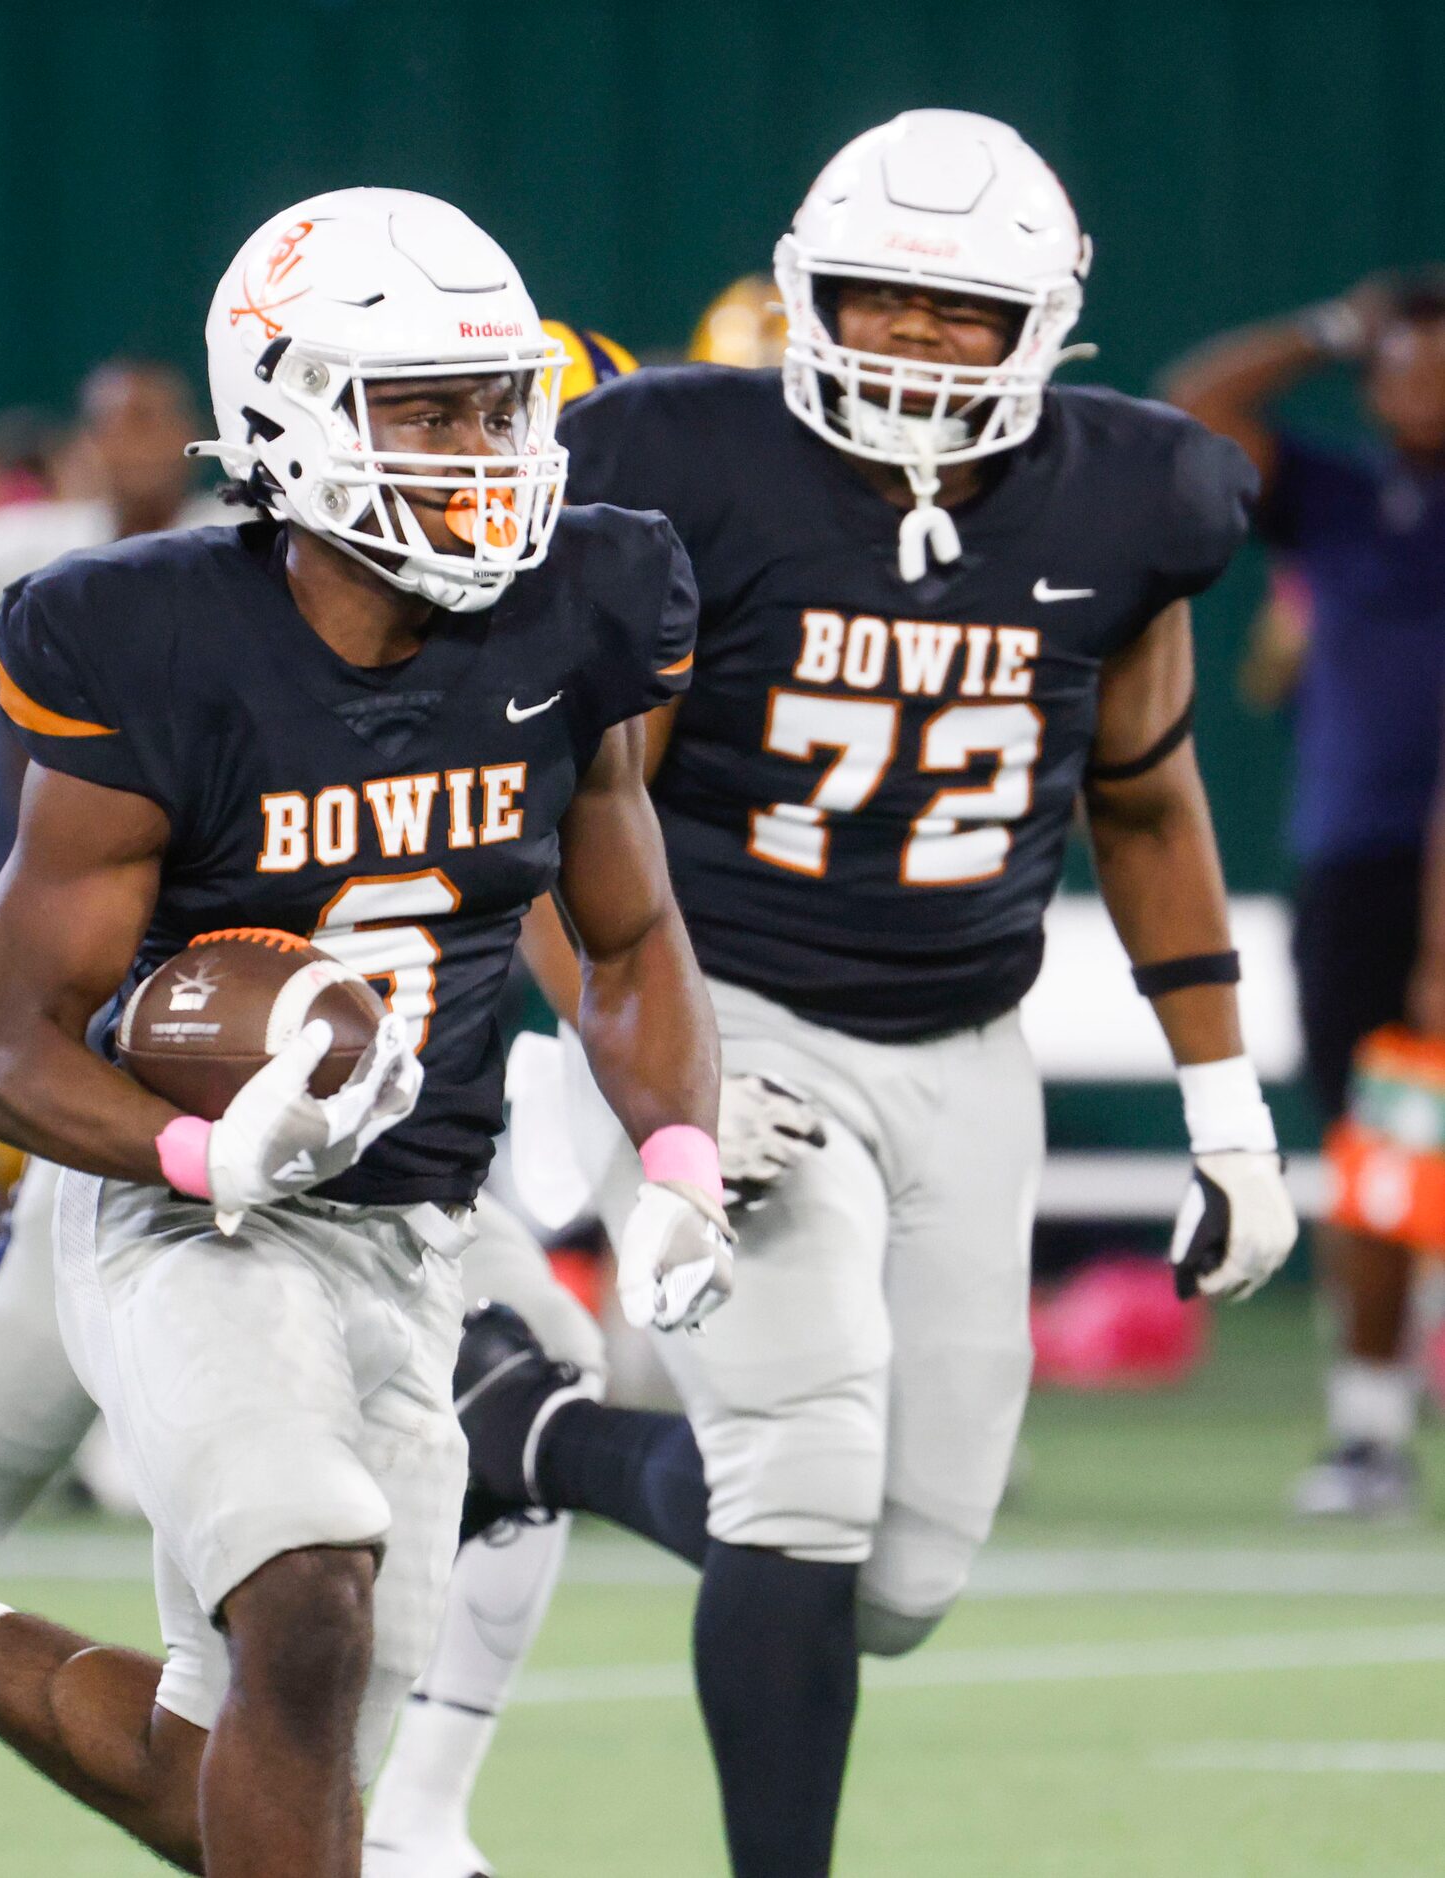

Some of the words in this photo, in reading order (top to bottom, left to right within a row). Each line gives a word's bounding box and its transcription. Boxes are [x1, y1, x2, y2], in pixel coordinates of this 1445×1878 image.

[793, 607, 1040, 697] BOWIE
[256, 761, 527, 873] BOWIE
[747, 686, 1045, 881] 72
[308, 867, 463, 1057] 6
